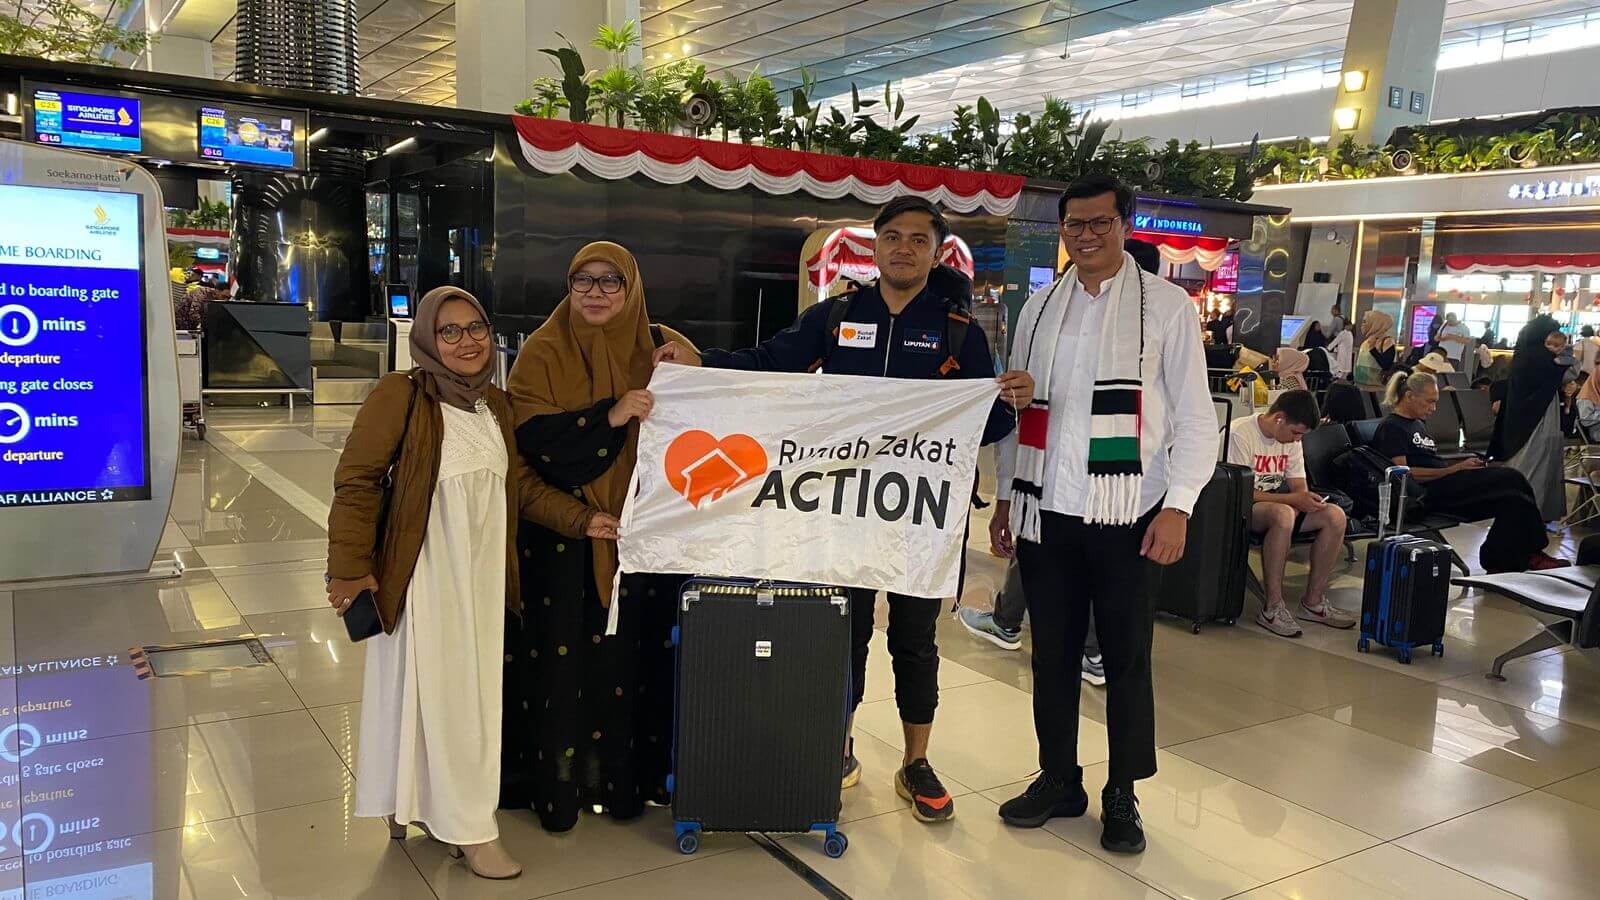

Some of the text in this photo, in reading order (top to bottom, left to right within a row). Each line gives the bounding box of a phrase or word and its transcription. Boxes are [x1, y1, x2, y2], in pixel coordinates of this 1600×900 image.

[67, 104, 115, 114] SINGAPORE
[78, 113, 115, 121] AIRLINES
[46, 168, 121, 183] Soekarno-Hatta
[1153, 219, 1202, 232] INDONESIA
[25, 246, 102, 260] BOARDING
[10, 284, 25, 296] to
[28, 283, 89, 302] boarding
[91, 287, 120, 303] gate
[42, 316, 87, 332] mins
[904, 340, 930, 348] LIPUTAN
[0, 351, 61, 368] departure
[20, 379, 49, 394] gate
[53, 378, 94, 391] closes
[34, 413, 79, 427] mins
[876, 432, 957, 466] Zakat
[3, 450, 64, 465] departure
[20, 490, 97, 504] ALLIANCE
[750, 468, 951, 529] ACTION
